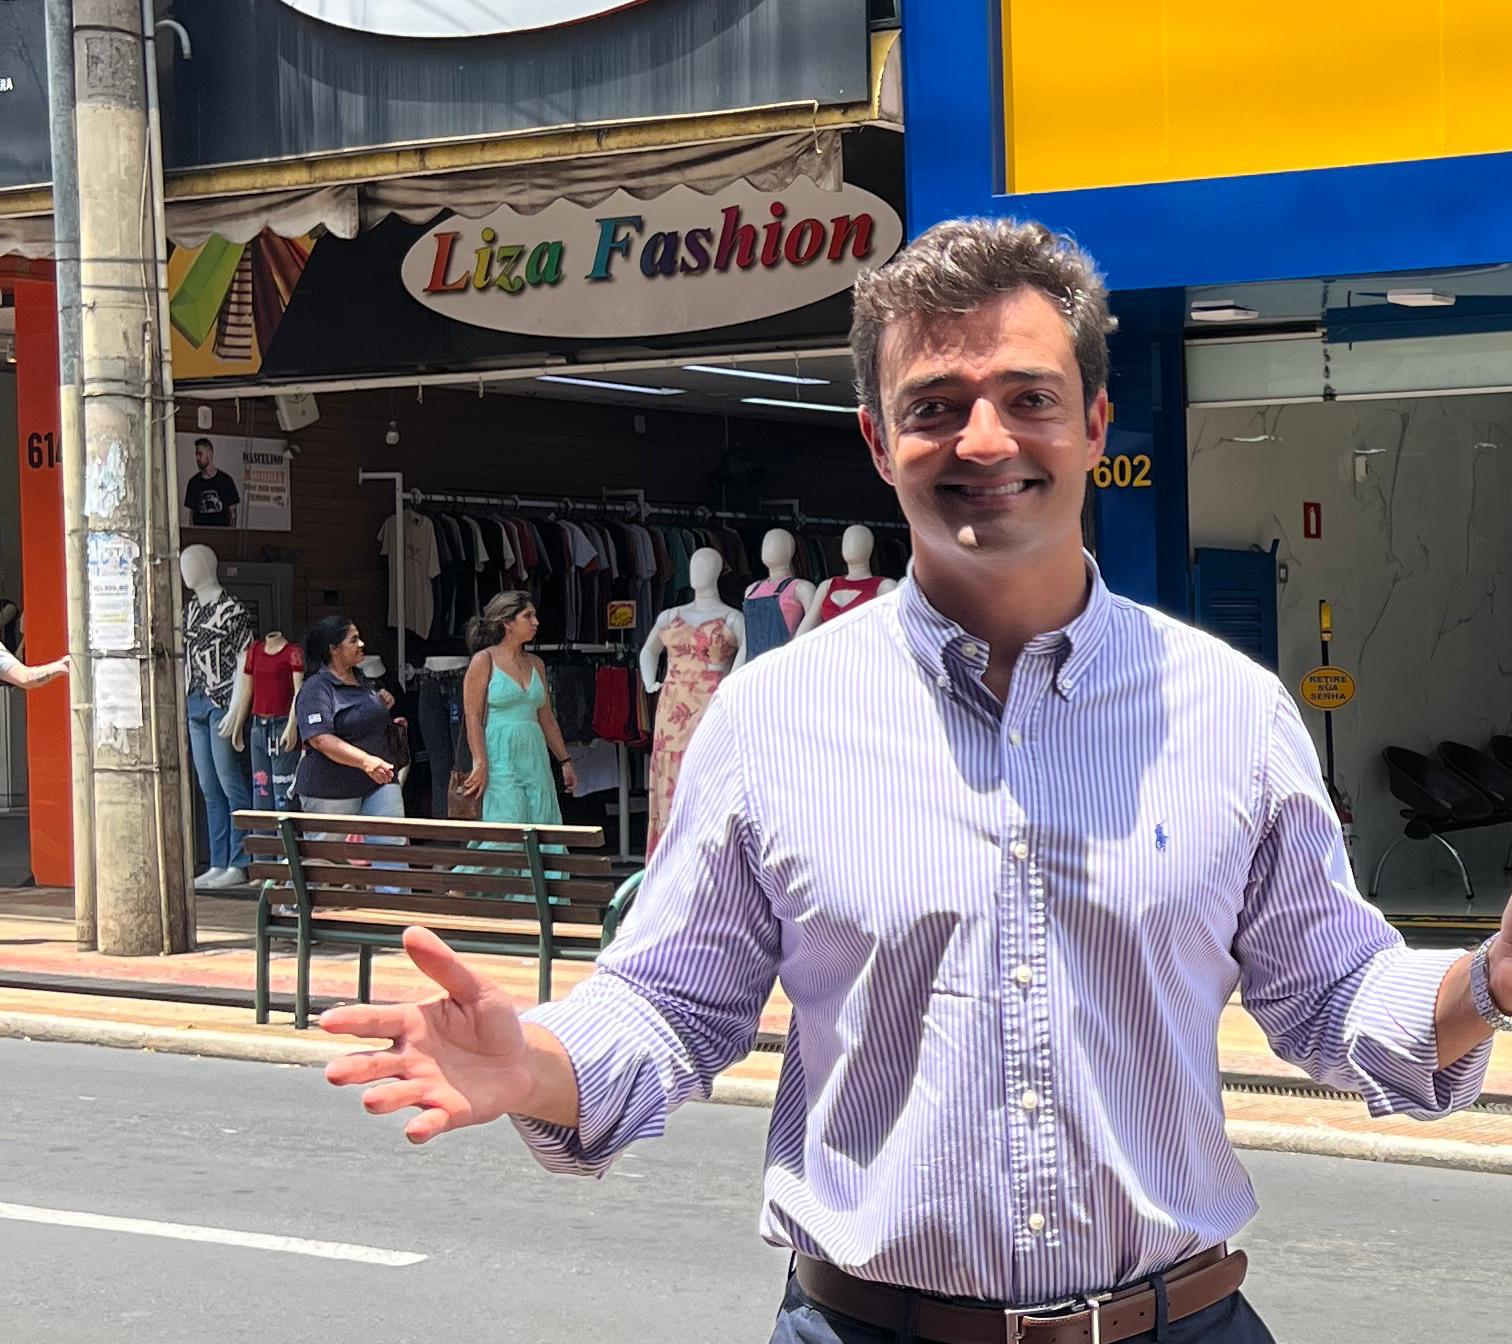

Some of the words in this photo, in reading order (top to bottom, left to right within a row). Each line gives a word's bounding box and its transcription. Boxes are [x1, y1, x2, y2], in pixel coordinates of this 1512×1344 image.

[422, 227, 564, 293] Liza
[585, 201, 874, 281] Fashion
[1093, 455, 1152, 488] 602
[1310, 692, 1346, 700] SENHA
